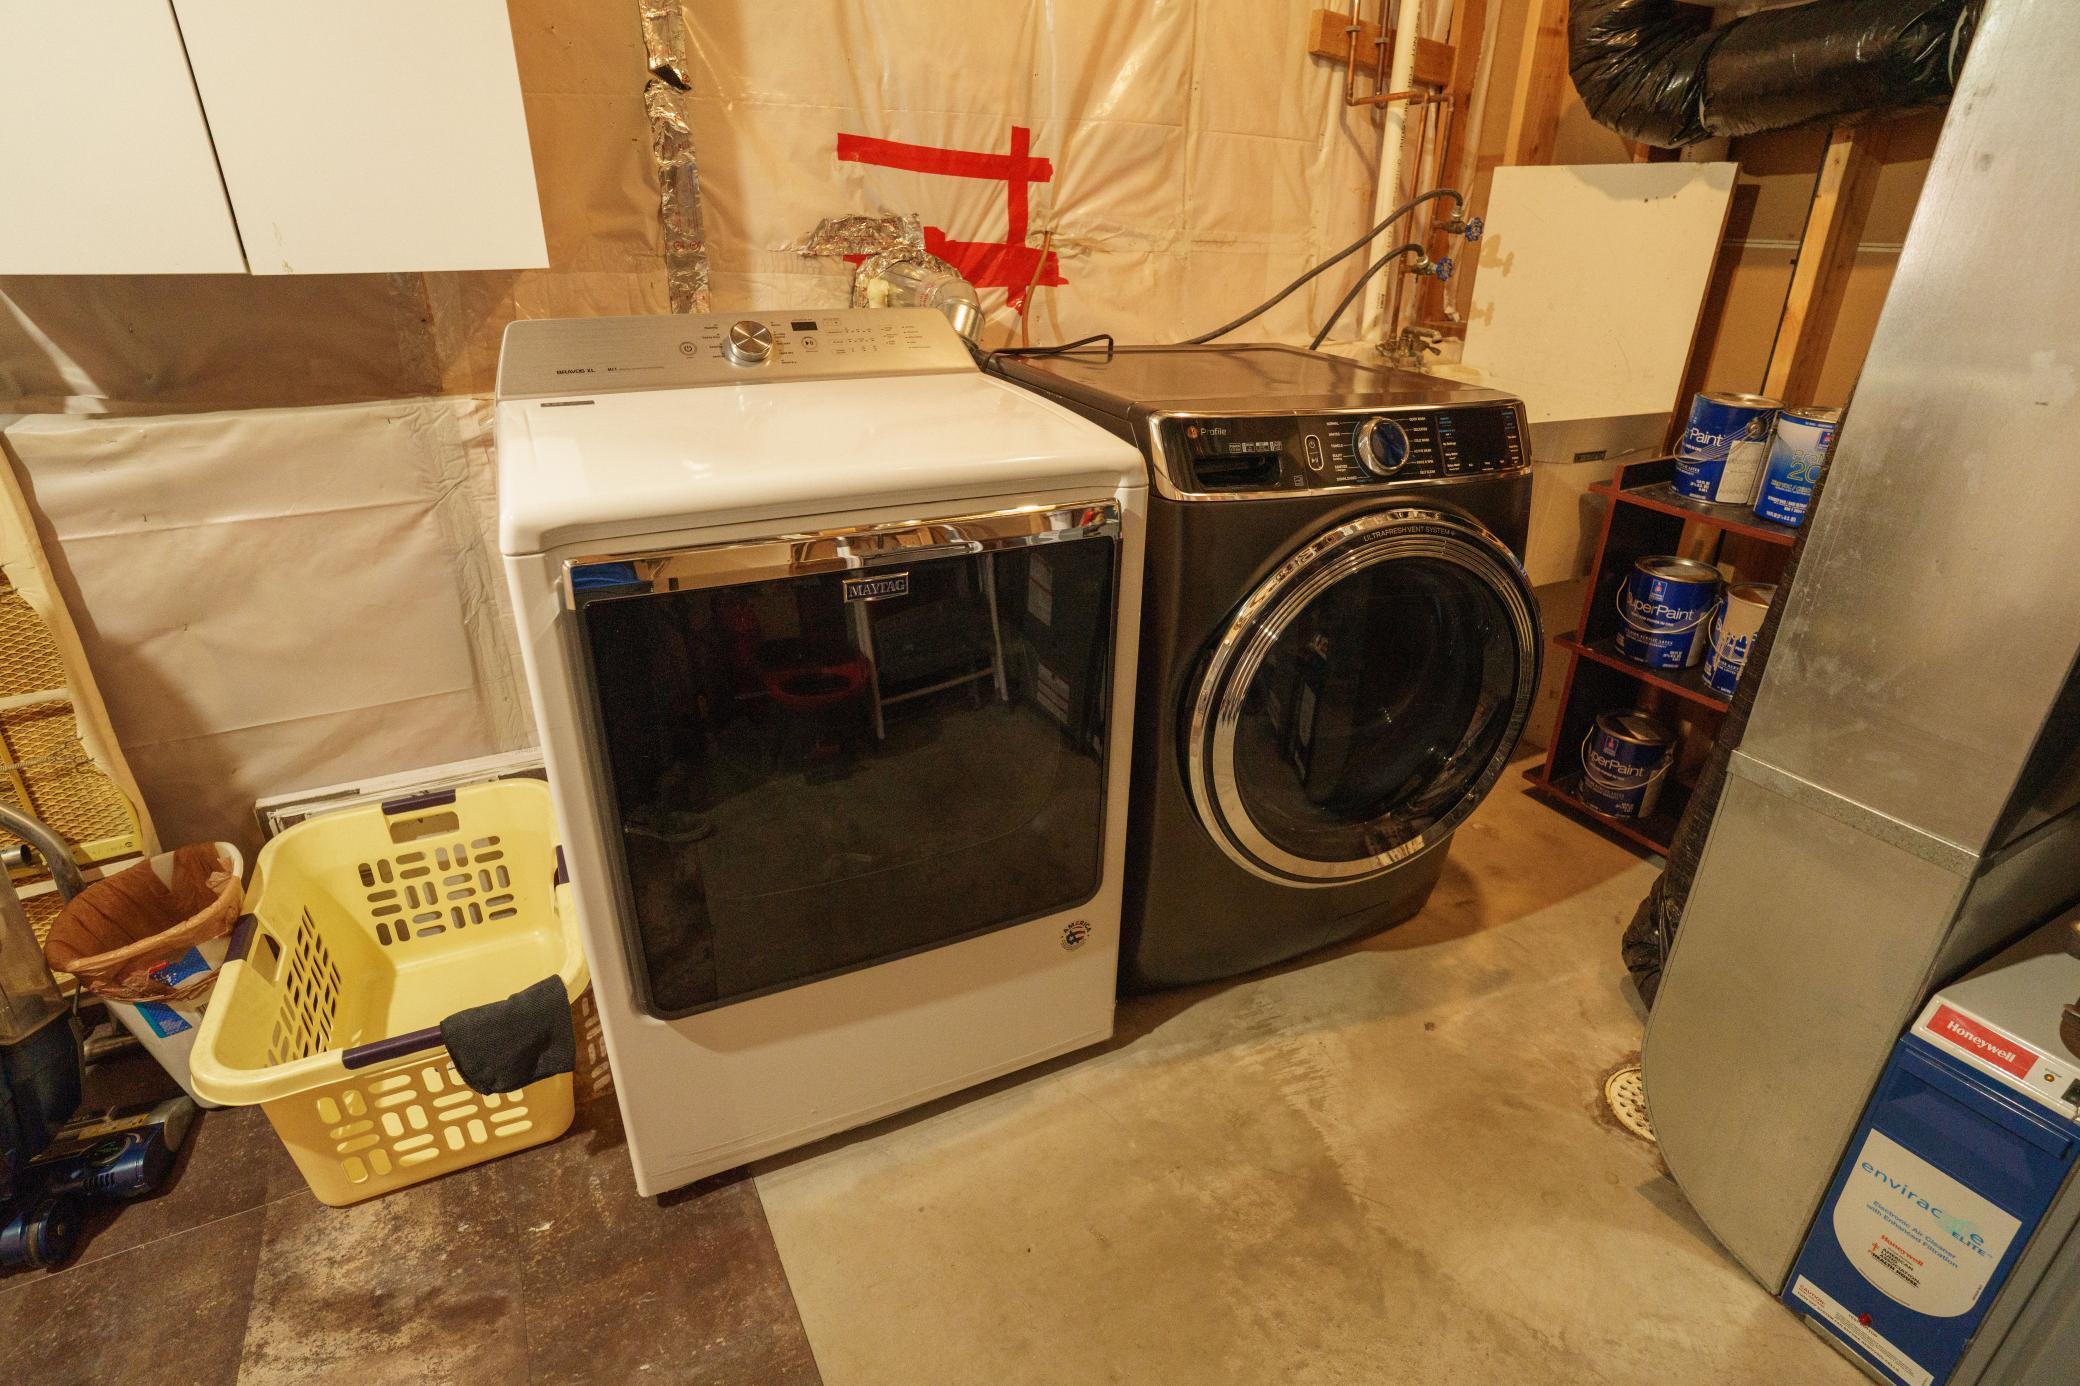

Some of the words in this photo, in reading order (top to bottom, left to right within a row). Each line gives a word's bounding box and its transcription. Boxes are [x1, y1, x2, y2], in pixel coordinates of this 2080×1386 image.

[1200, 427, 1227, 436] Profile
[1363, 527, 1406, 542] ULTRAFRESH
[1406, 525, 1425, 533] VENT
[1425, 526, 1450, 536] SYSTEM
[848, 579, 905, 598] MAYTAG
[1946, 1020, 2017, 1063] Honeywell
[1861, 1161, 1985, 1246] envirace
[1873, 1200, 1911, 1228] Electronic
[1912, 1227, 1925, 1237] Air
[1925, 1234, 1957, 1259] Cleaner
[1883, 1214, 1921, 1244] Enhanced
[1922, 1241, 1958, 1269] Filtration
[1951, 1231, 1985, 1257] ELITE
[1881, 1234, 1924, 1267] Honeywell
